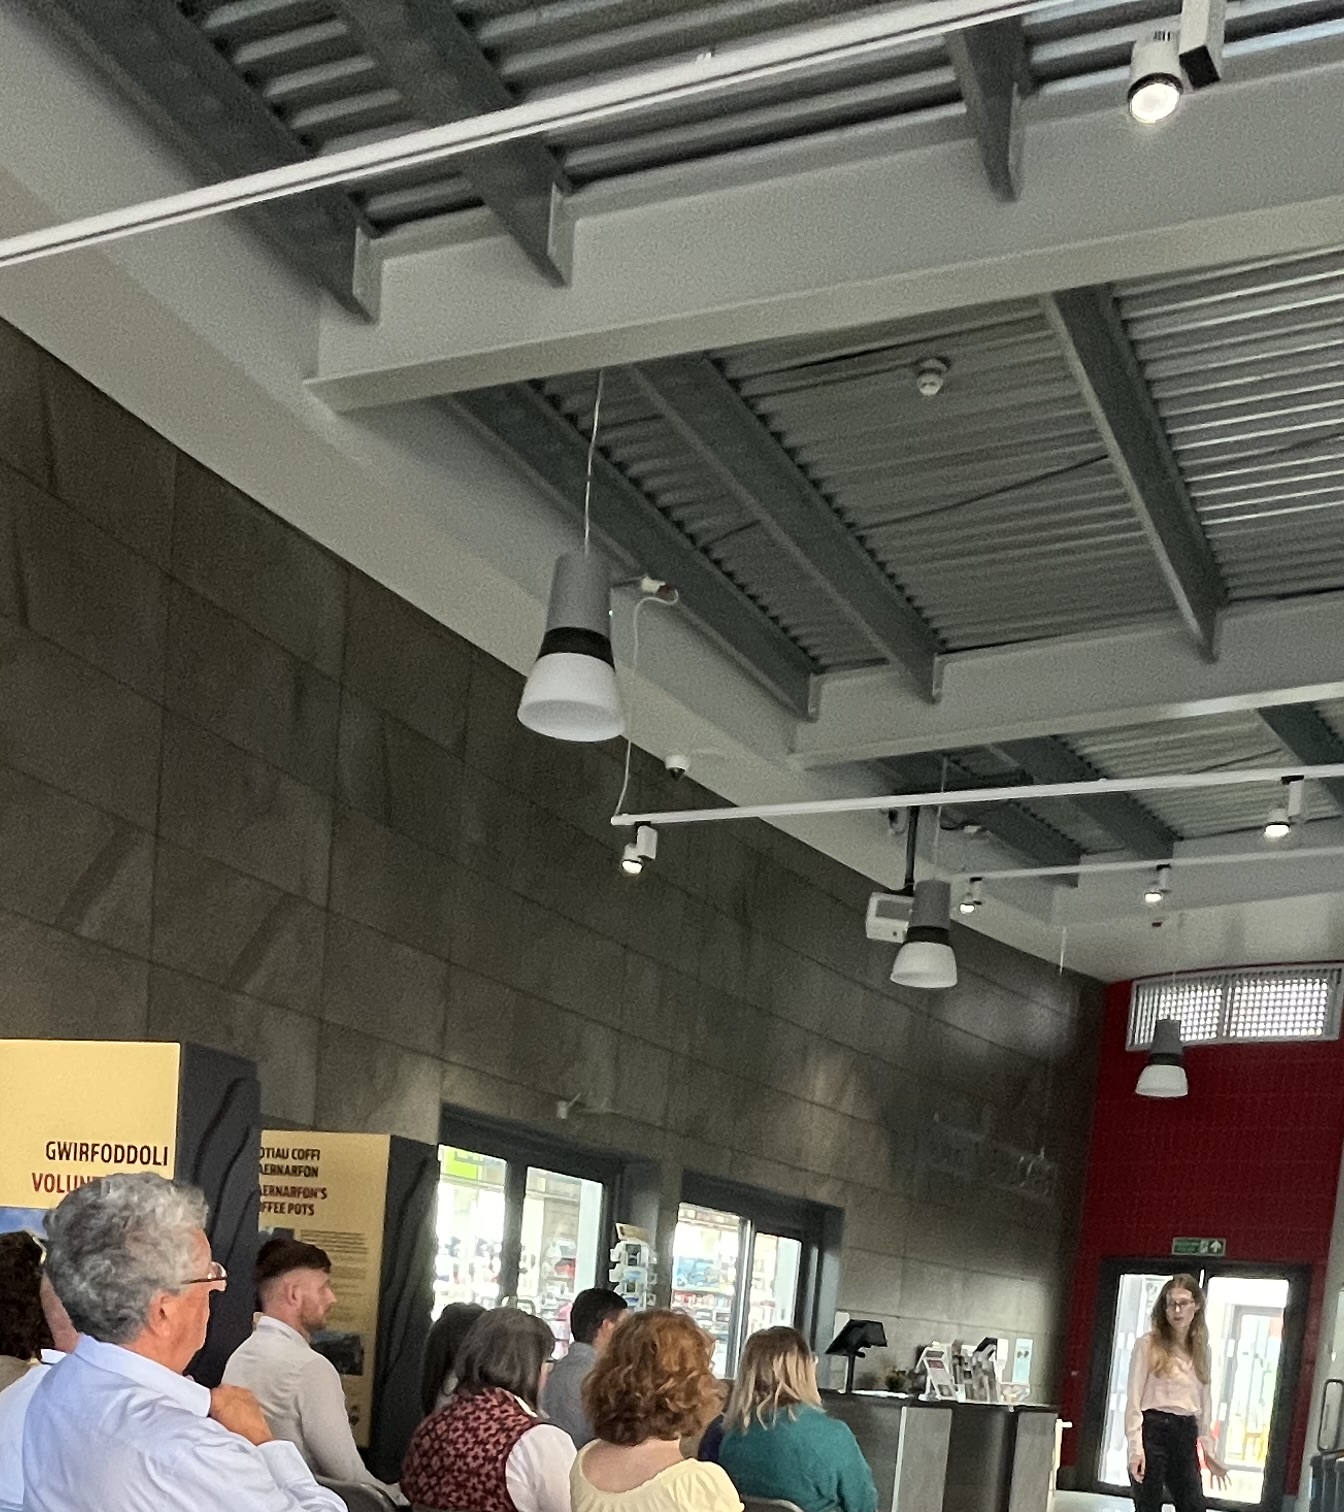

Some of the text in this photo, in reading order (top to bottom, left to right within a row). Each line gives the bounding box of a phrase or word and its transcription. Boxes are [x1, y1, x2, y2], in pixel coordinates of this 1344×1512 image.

[45, 1140, 169, 1167] GWIRFODDOLI
[259, 1146, 321, 1162] OTIAU COFFI
[287, 1202, 315, 1216] POTS
